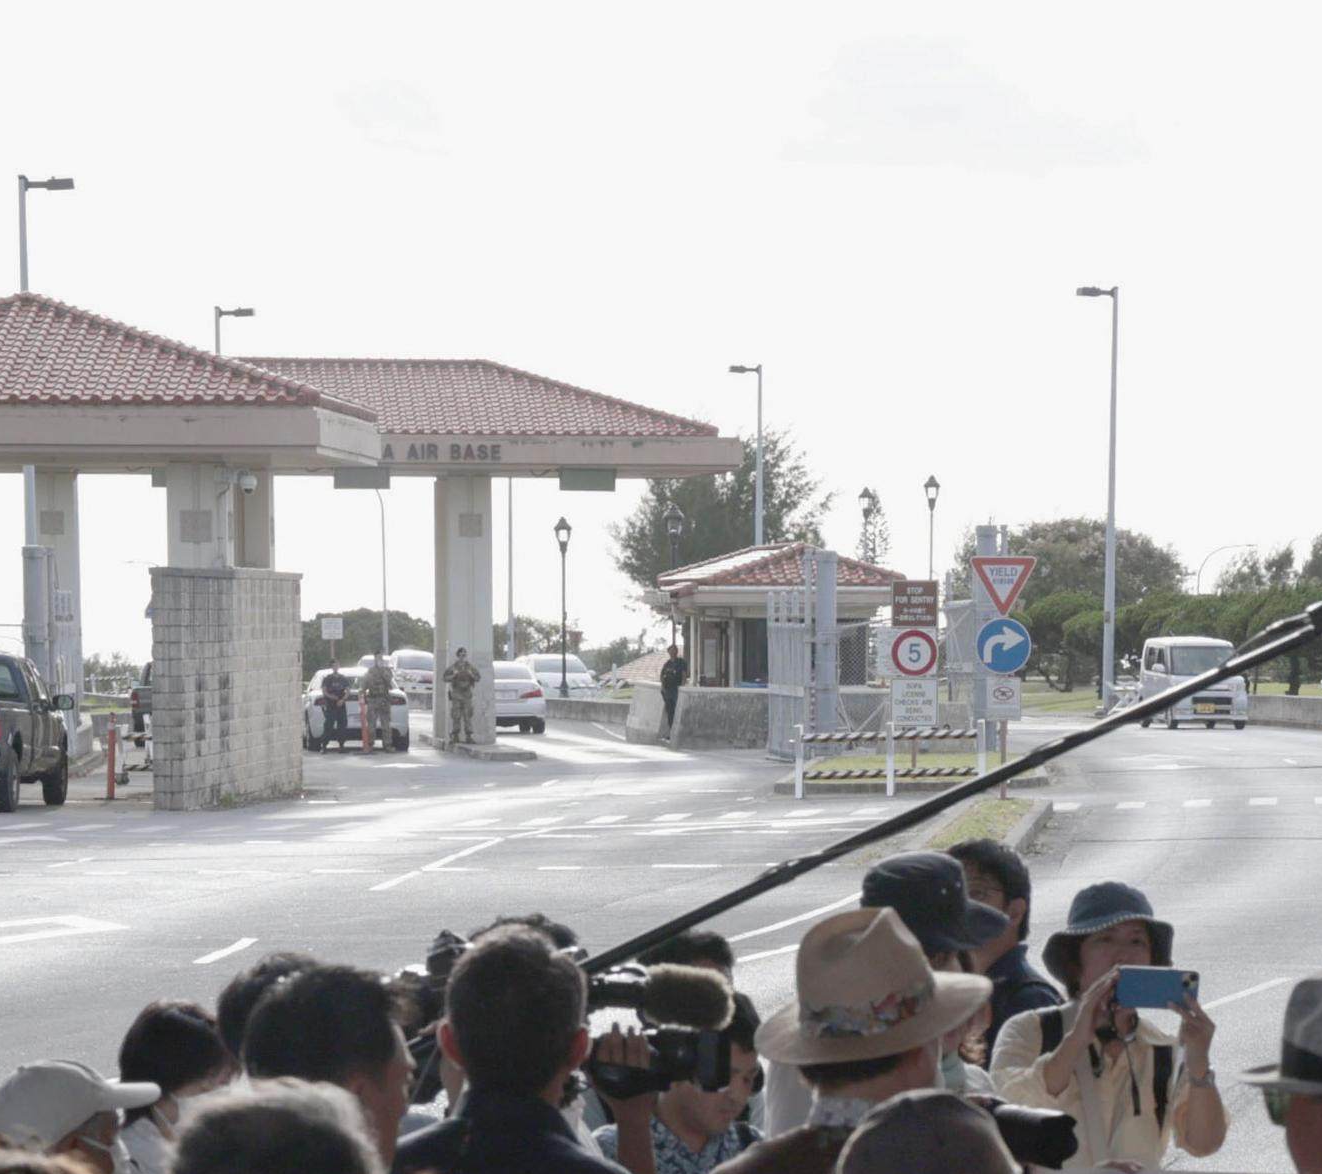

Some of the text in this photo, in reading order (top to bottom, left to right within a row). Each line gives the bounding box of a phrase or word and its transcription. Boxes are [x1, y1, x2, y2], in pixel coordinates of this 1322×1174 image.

[406, 443, 439, 461] AIR
[450, 443, 502, 461] BASE
[989, 566, 1018, 577] YIELD
[908, 643, 921, 663] 5
